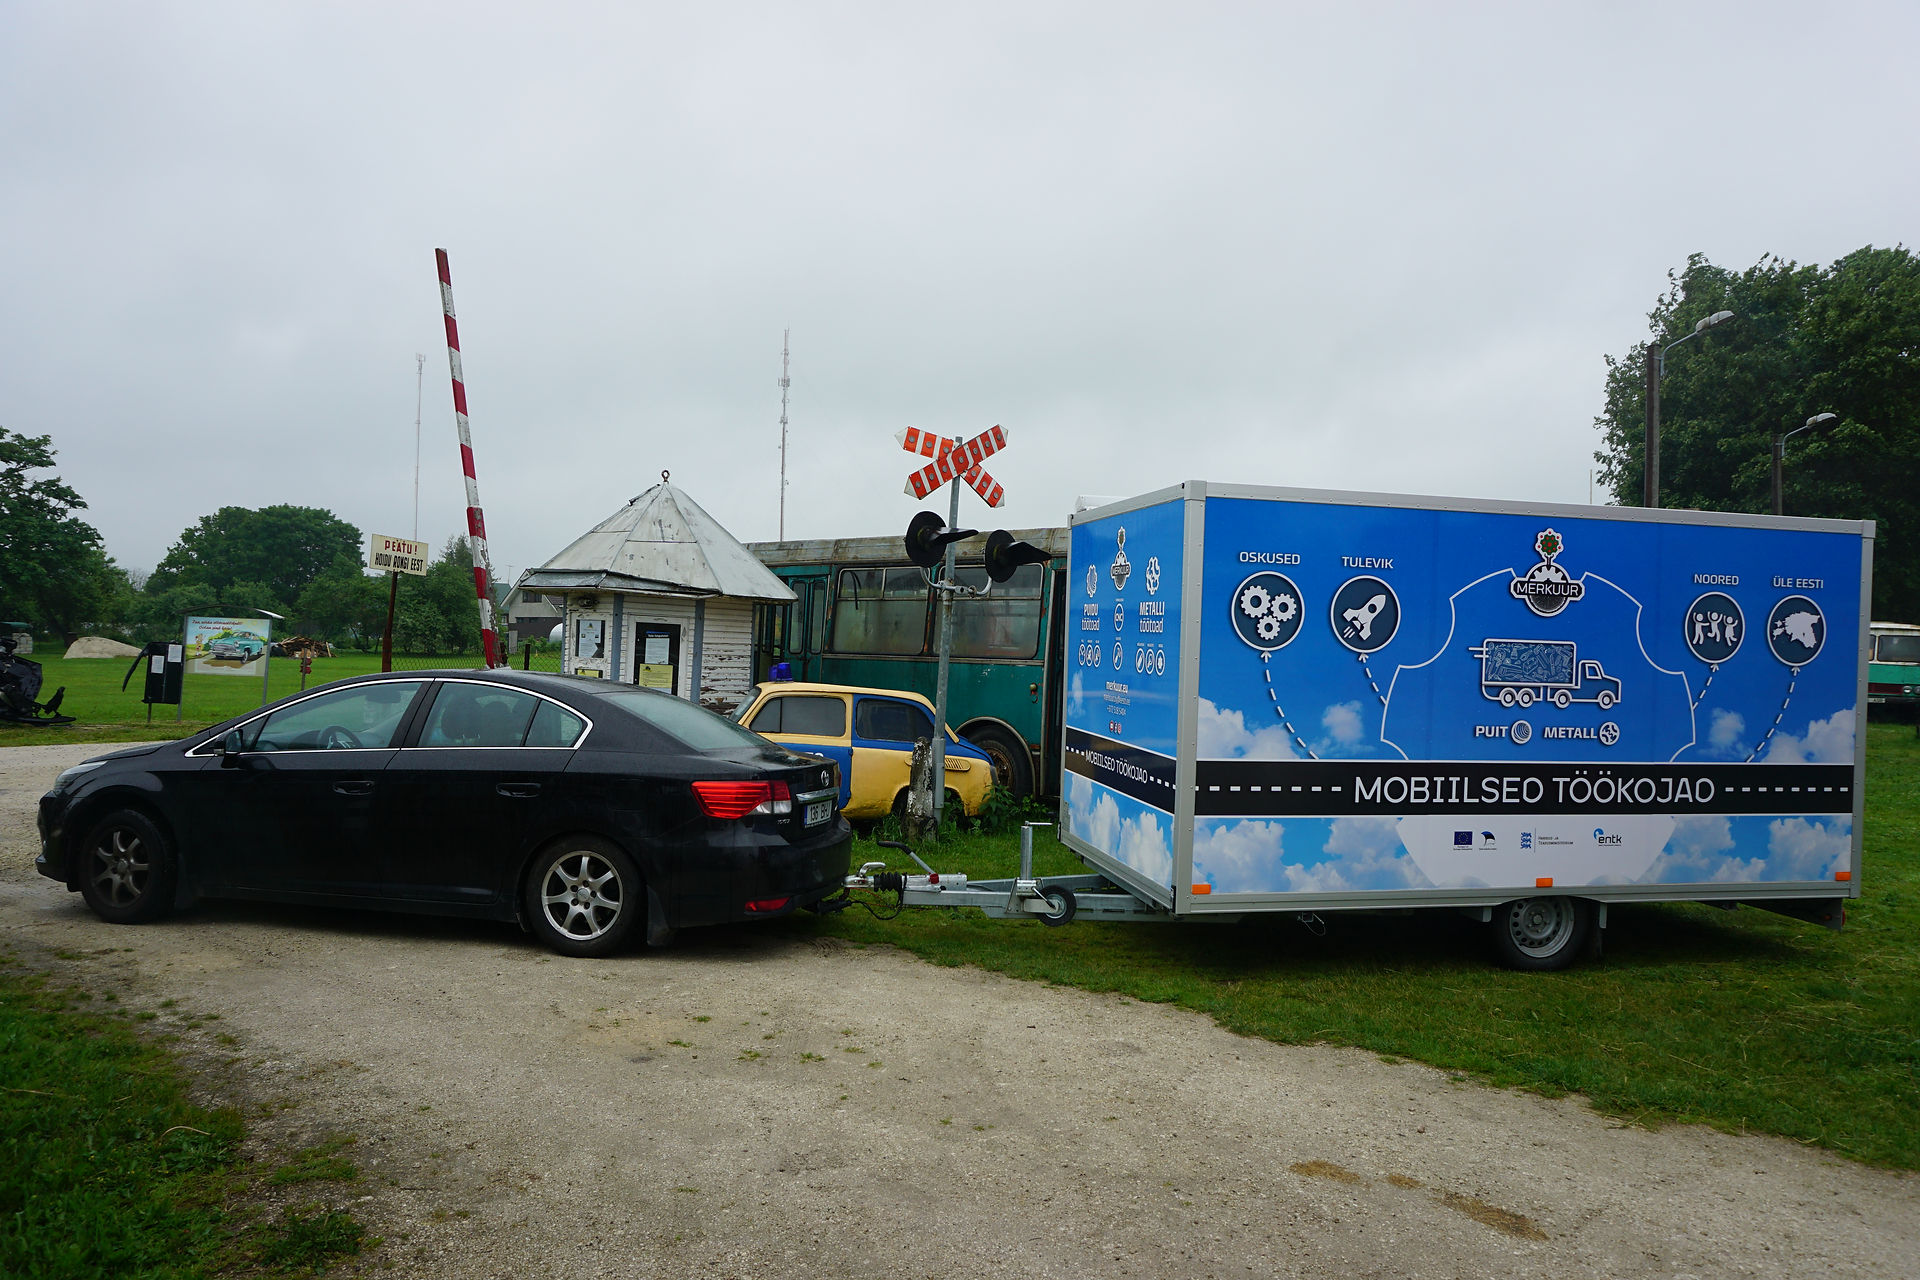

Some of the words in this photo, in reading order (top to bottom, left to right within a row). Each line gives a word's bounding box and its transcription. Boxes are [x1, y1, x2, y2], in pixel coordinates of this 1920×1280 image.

[410, 558, 423, 572] EEST
[1239, 551, 1301, 565] OSKUSED
[1342, 556, 1394, 569] TULEVIK
[1694, 574, 1739, 586] NOORED
[1773, 575, 1792, 588] ÜLE
[1796, 578, 1824, 589] EESTI
[1516, 581, 1579, 597] MERKUUR
[1139, 601, 1165, 616] METALLI
[1139, 617, 1164, 633] töötoad
[1475, 725, 1508, 737] PUIT
[1543, 726, 1597, 739] METALL
[1355, 776, 1544, 803] MOBIILSED
[1552, 770, 1715, 803] TÖÖKOJAD
[1598, 834, 1622, 844] entk
